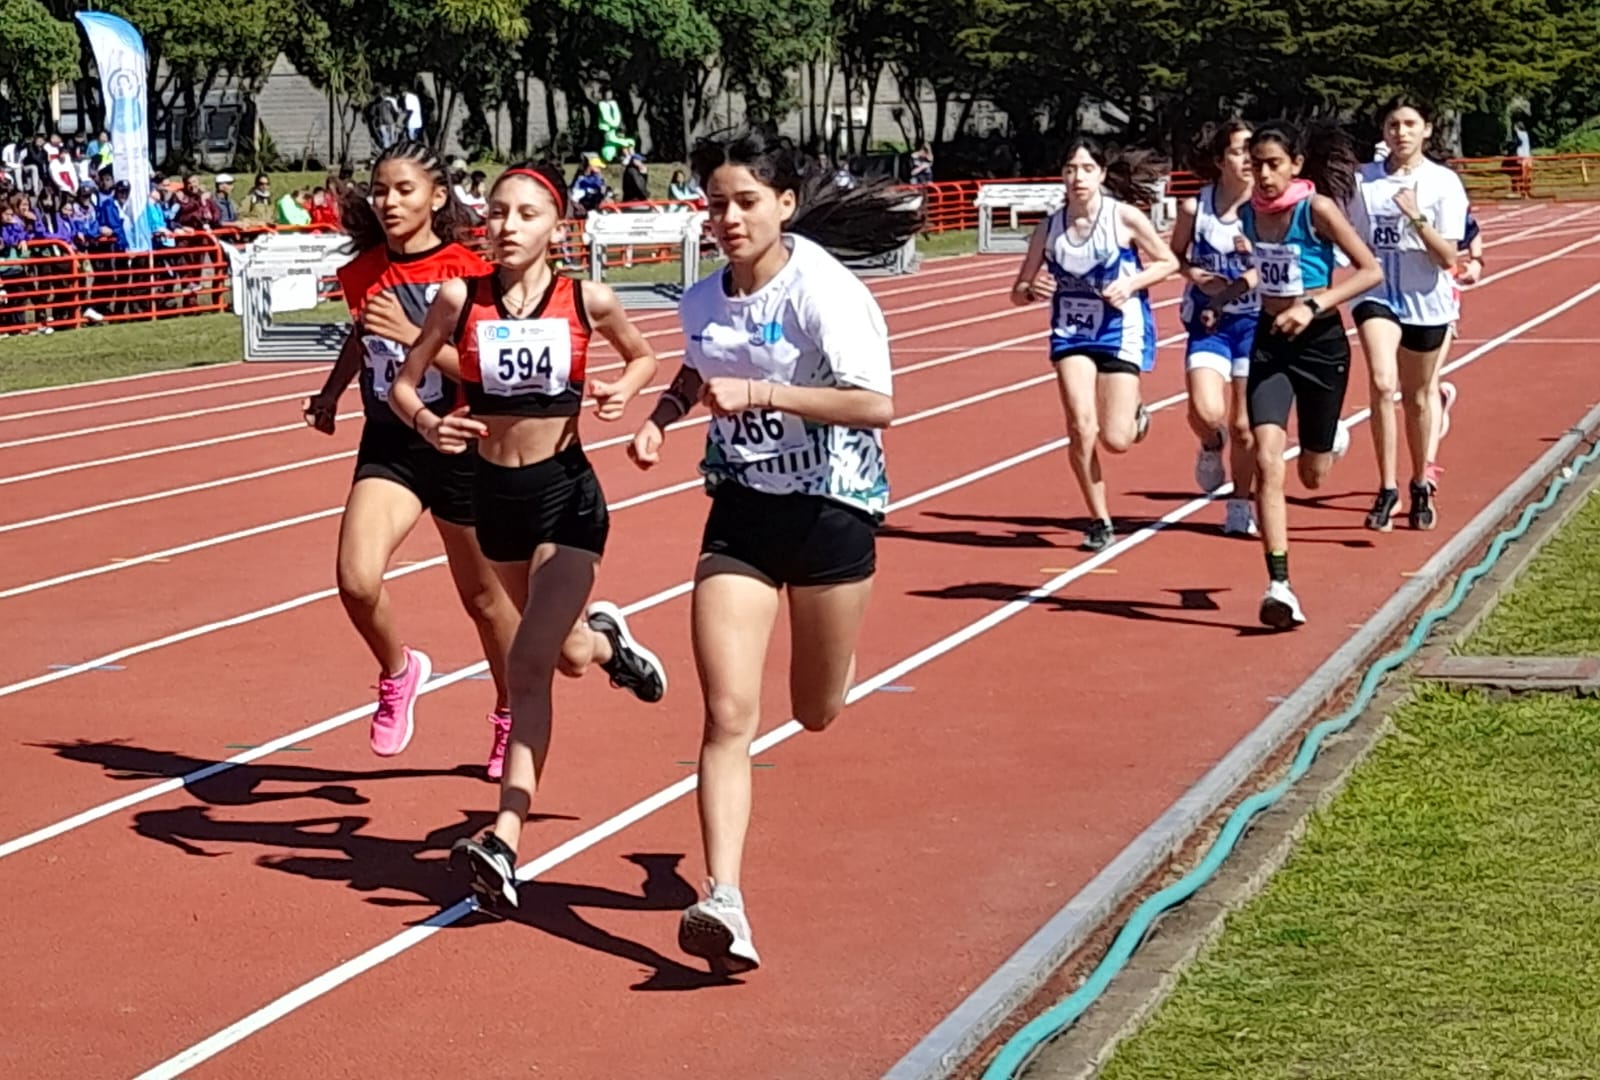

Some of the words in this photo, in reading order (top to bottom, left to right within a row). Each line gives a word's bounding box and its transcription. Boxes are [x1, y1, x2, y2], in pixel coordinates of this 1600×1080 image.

[1260, 262, 1290, 285] 504
[498, 346, 553, 381] 594
[727, 410, 784, 445] 266
